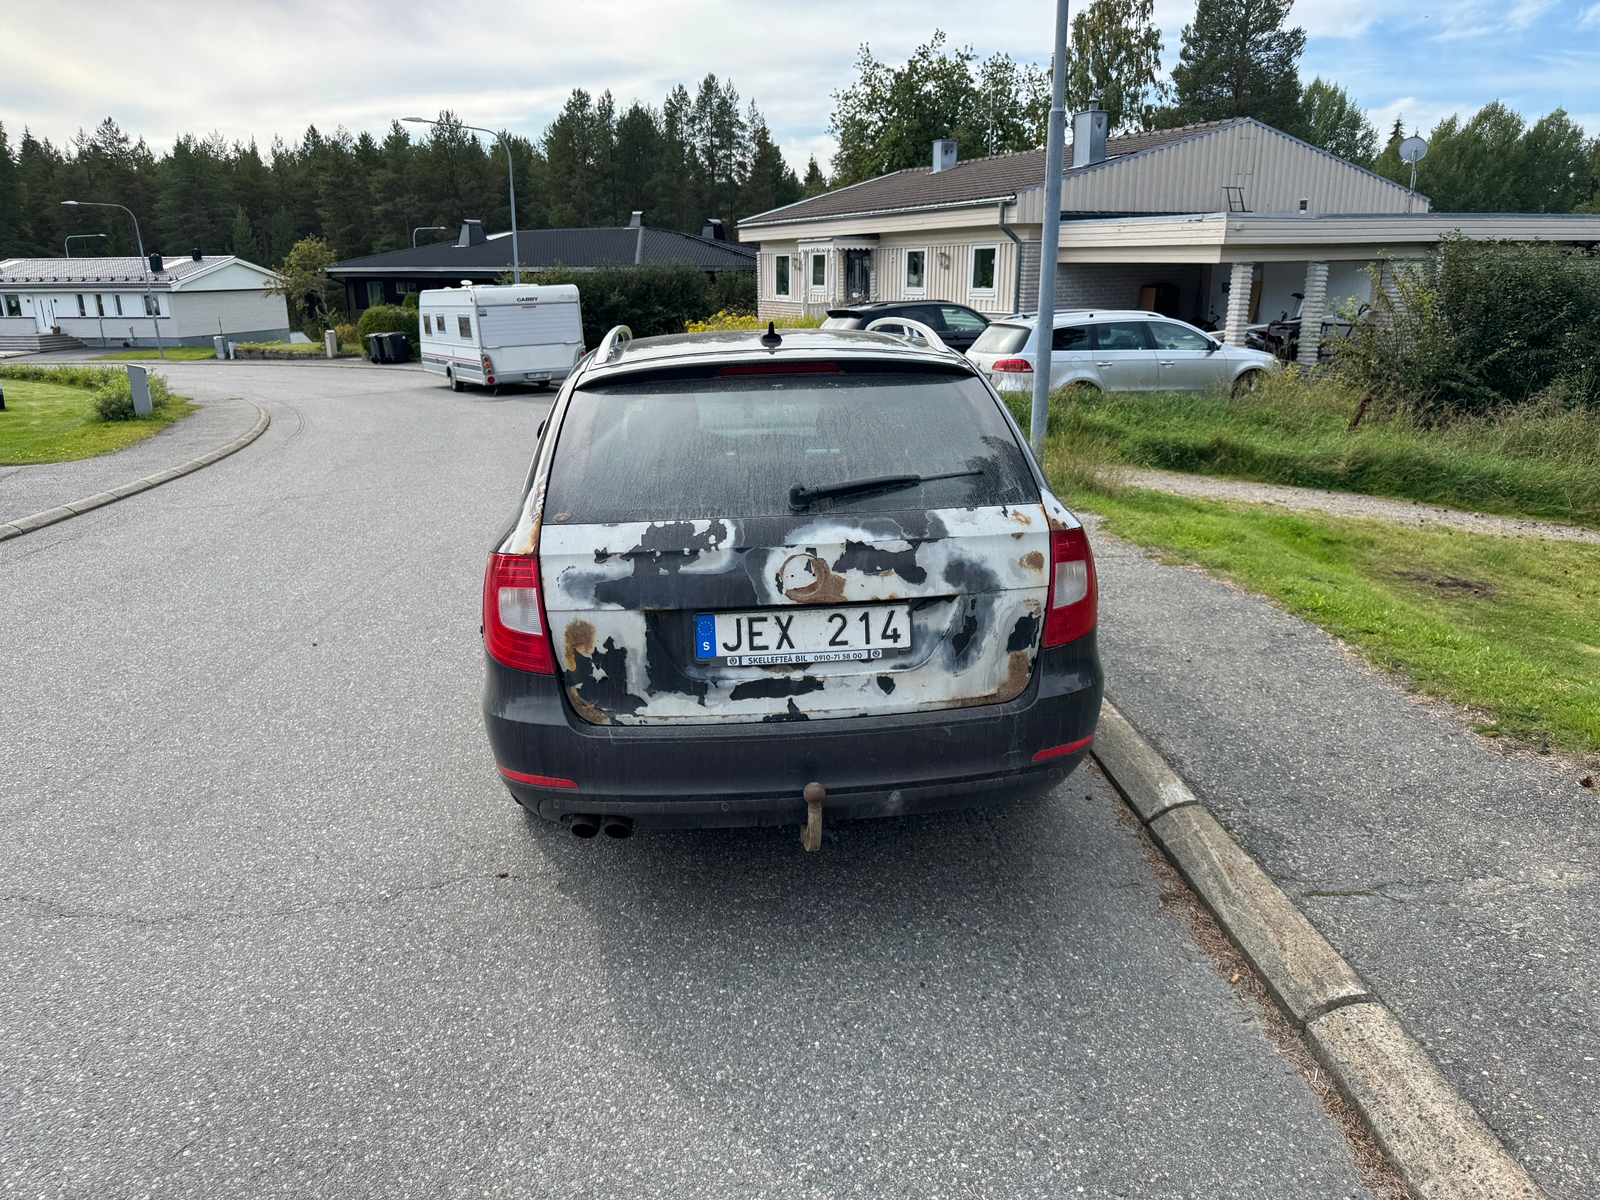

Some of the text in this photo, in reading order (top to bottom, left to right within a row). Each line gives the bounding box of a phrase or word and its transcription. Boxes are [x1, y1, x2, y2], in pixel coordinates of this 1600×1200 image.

[722, 610, 901, 651] JEX 214
[703, 641, 710, 651] S
[748, 654, 793, 665] SKELLEFTEÅ
